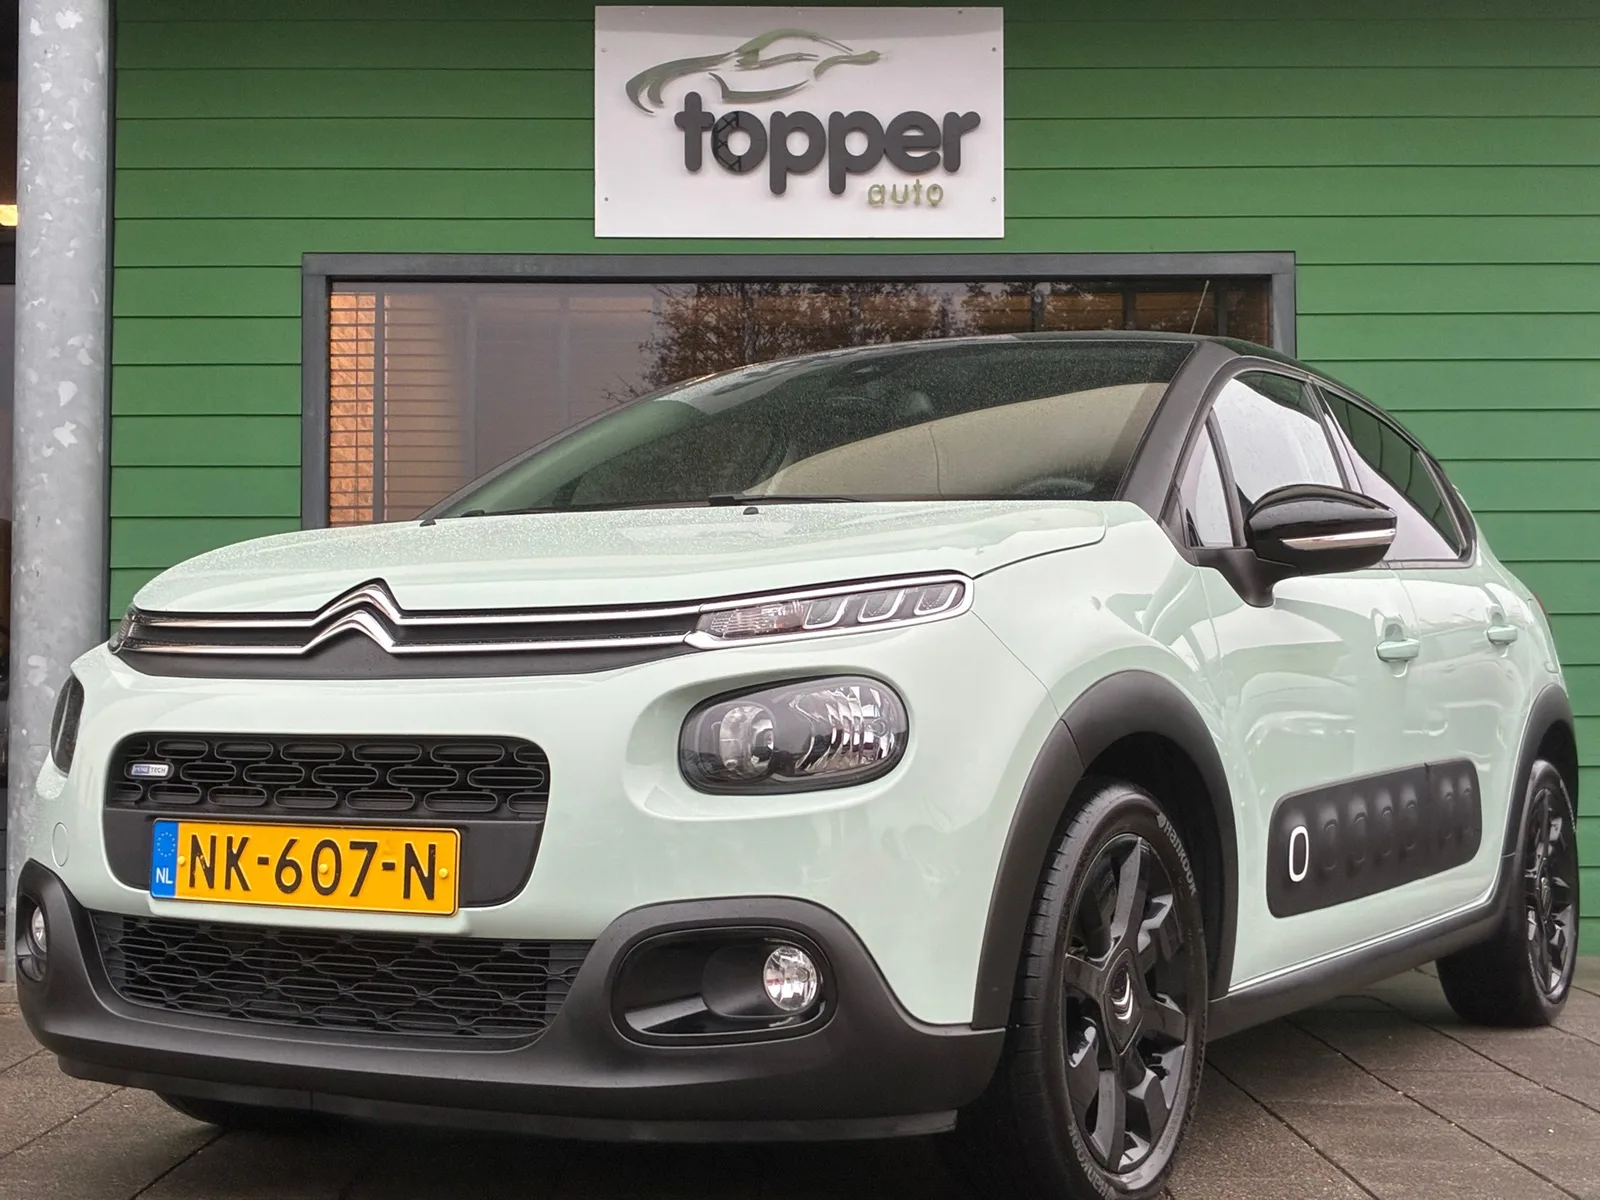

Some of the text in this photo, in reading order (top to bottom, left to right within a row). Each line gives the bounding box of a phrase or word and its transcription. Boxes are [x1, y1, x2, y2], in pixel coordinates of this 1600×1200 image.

[674, 91, 981, 195] topper
[867, 178, 944, 207] auto
[155, 867, 174, 884] NL
[188, 833, 437, 901] NK-607-N
